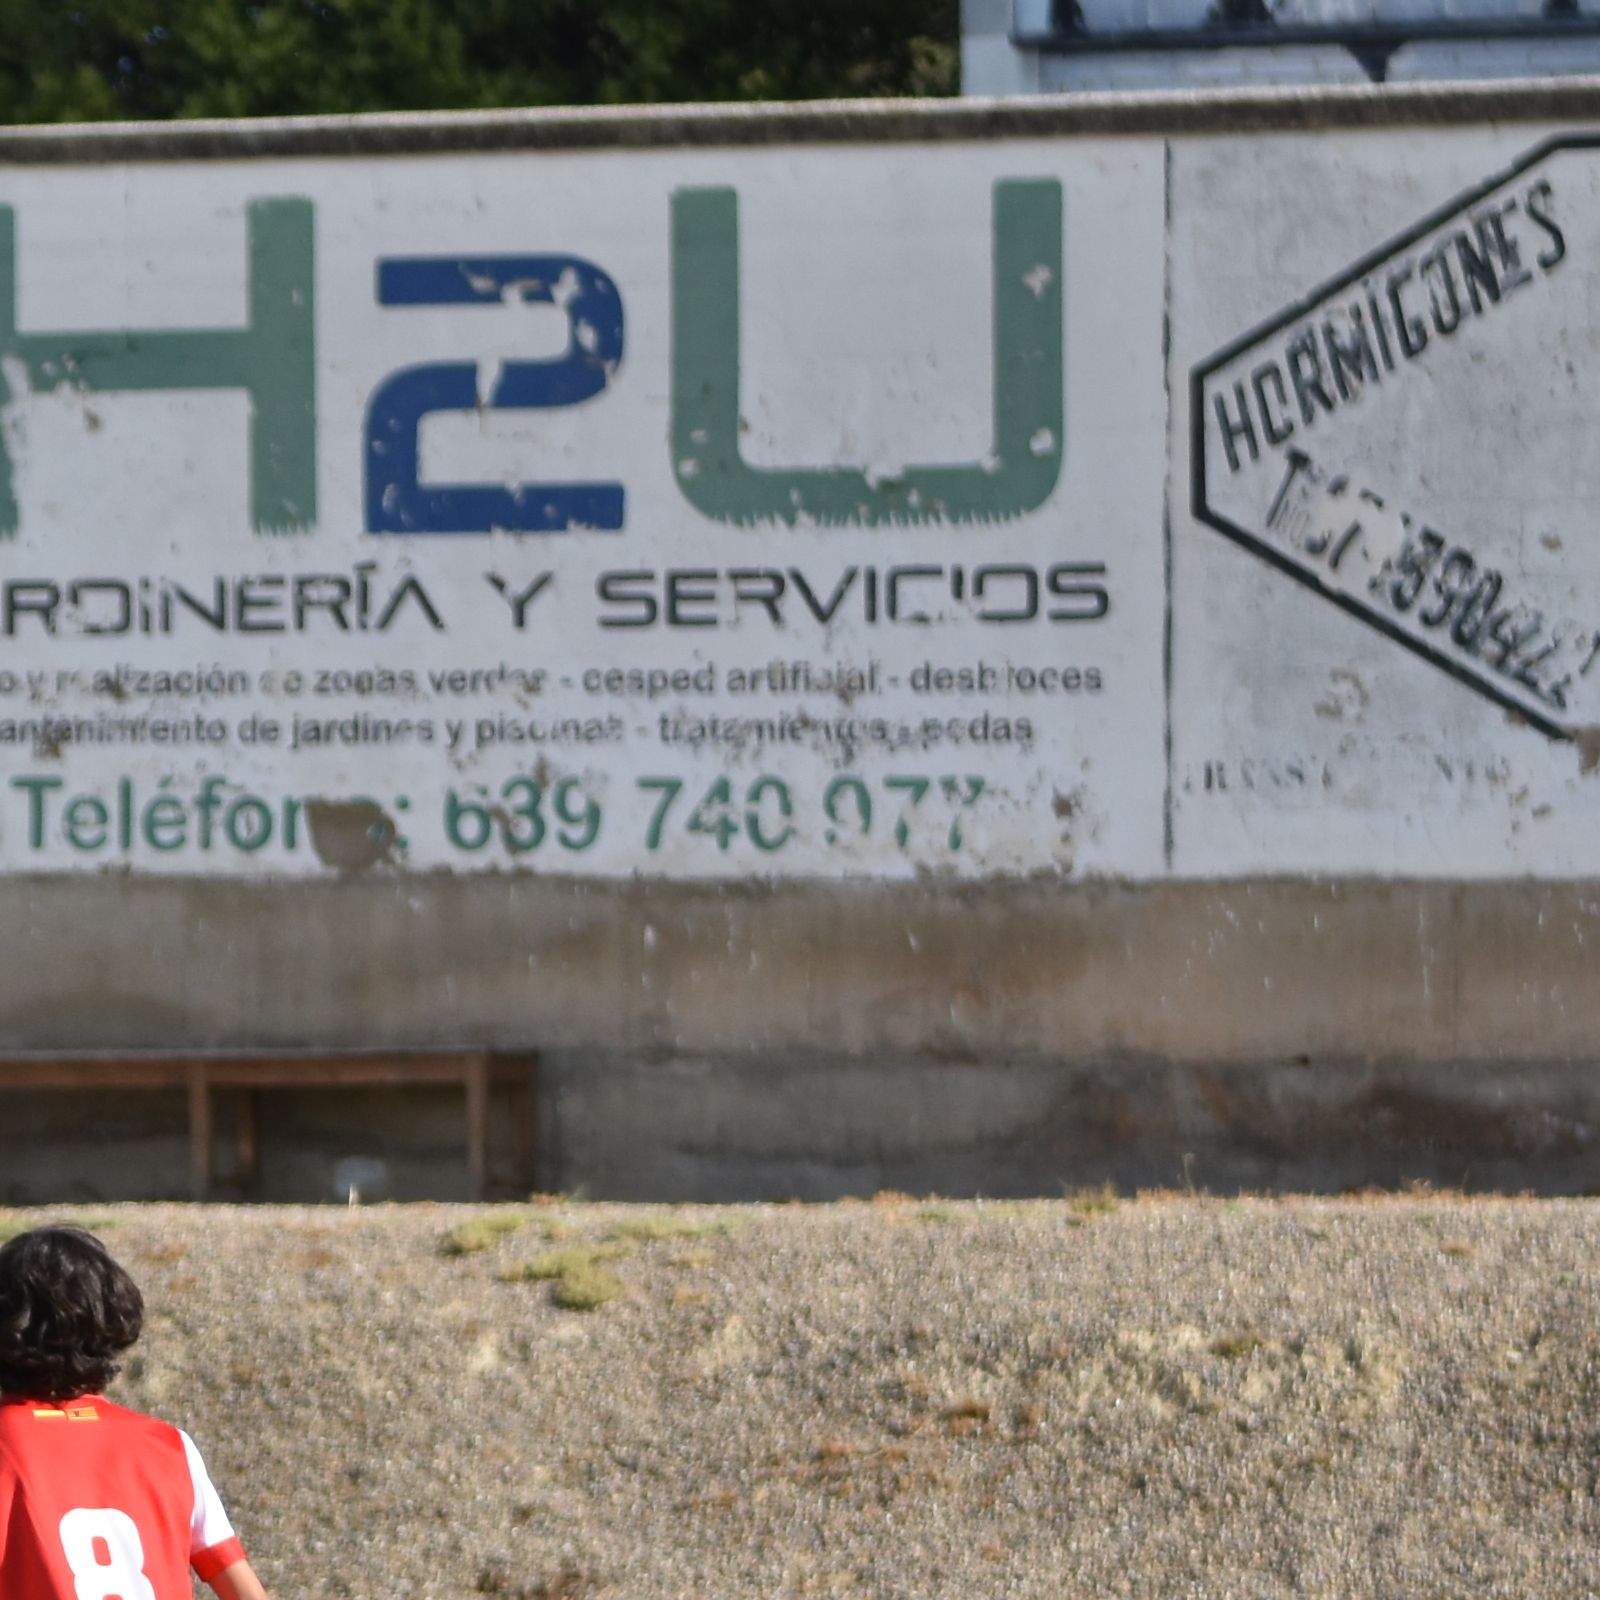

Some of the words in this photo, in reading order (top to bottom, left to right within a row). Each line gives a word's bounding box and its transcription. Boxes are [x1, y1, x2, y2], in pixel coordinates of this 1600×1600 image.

[1212, 178, 1568, 473] HORMIGONES
[484, 569, 554, 629] Y
[594, 560, 1111, 627] SERVICIOS
[237, 712, 279, 743] de
[446, 718, 465, 749] y
[442, 774, 602, 853] 639
[634, 773, 796, 852] 740
